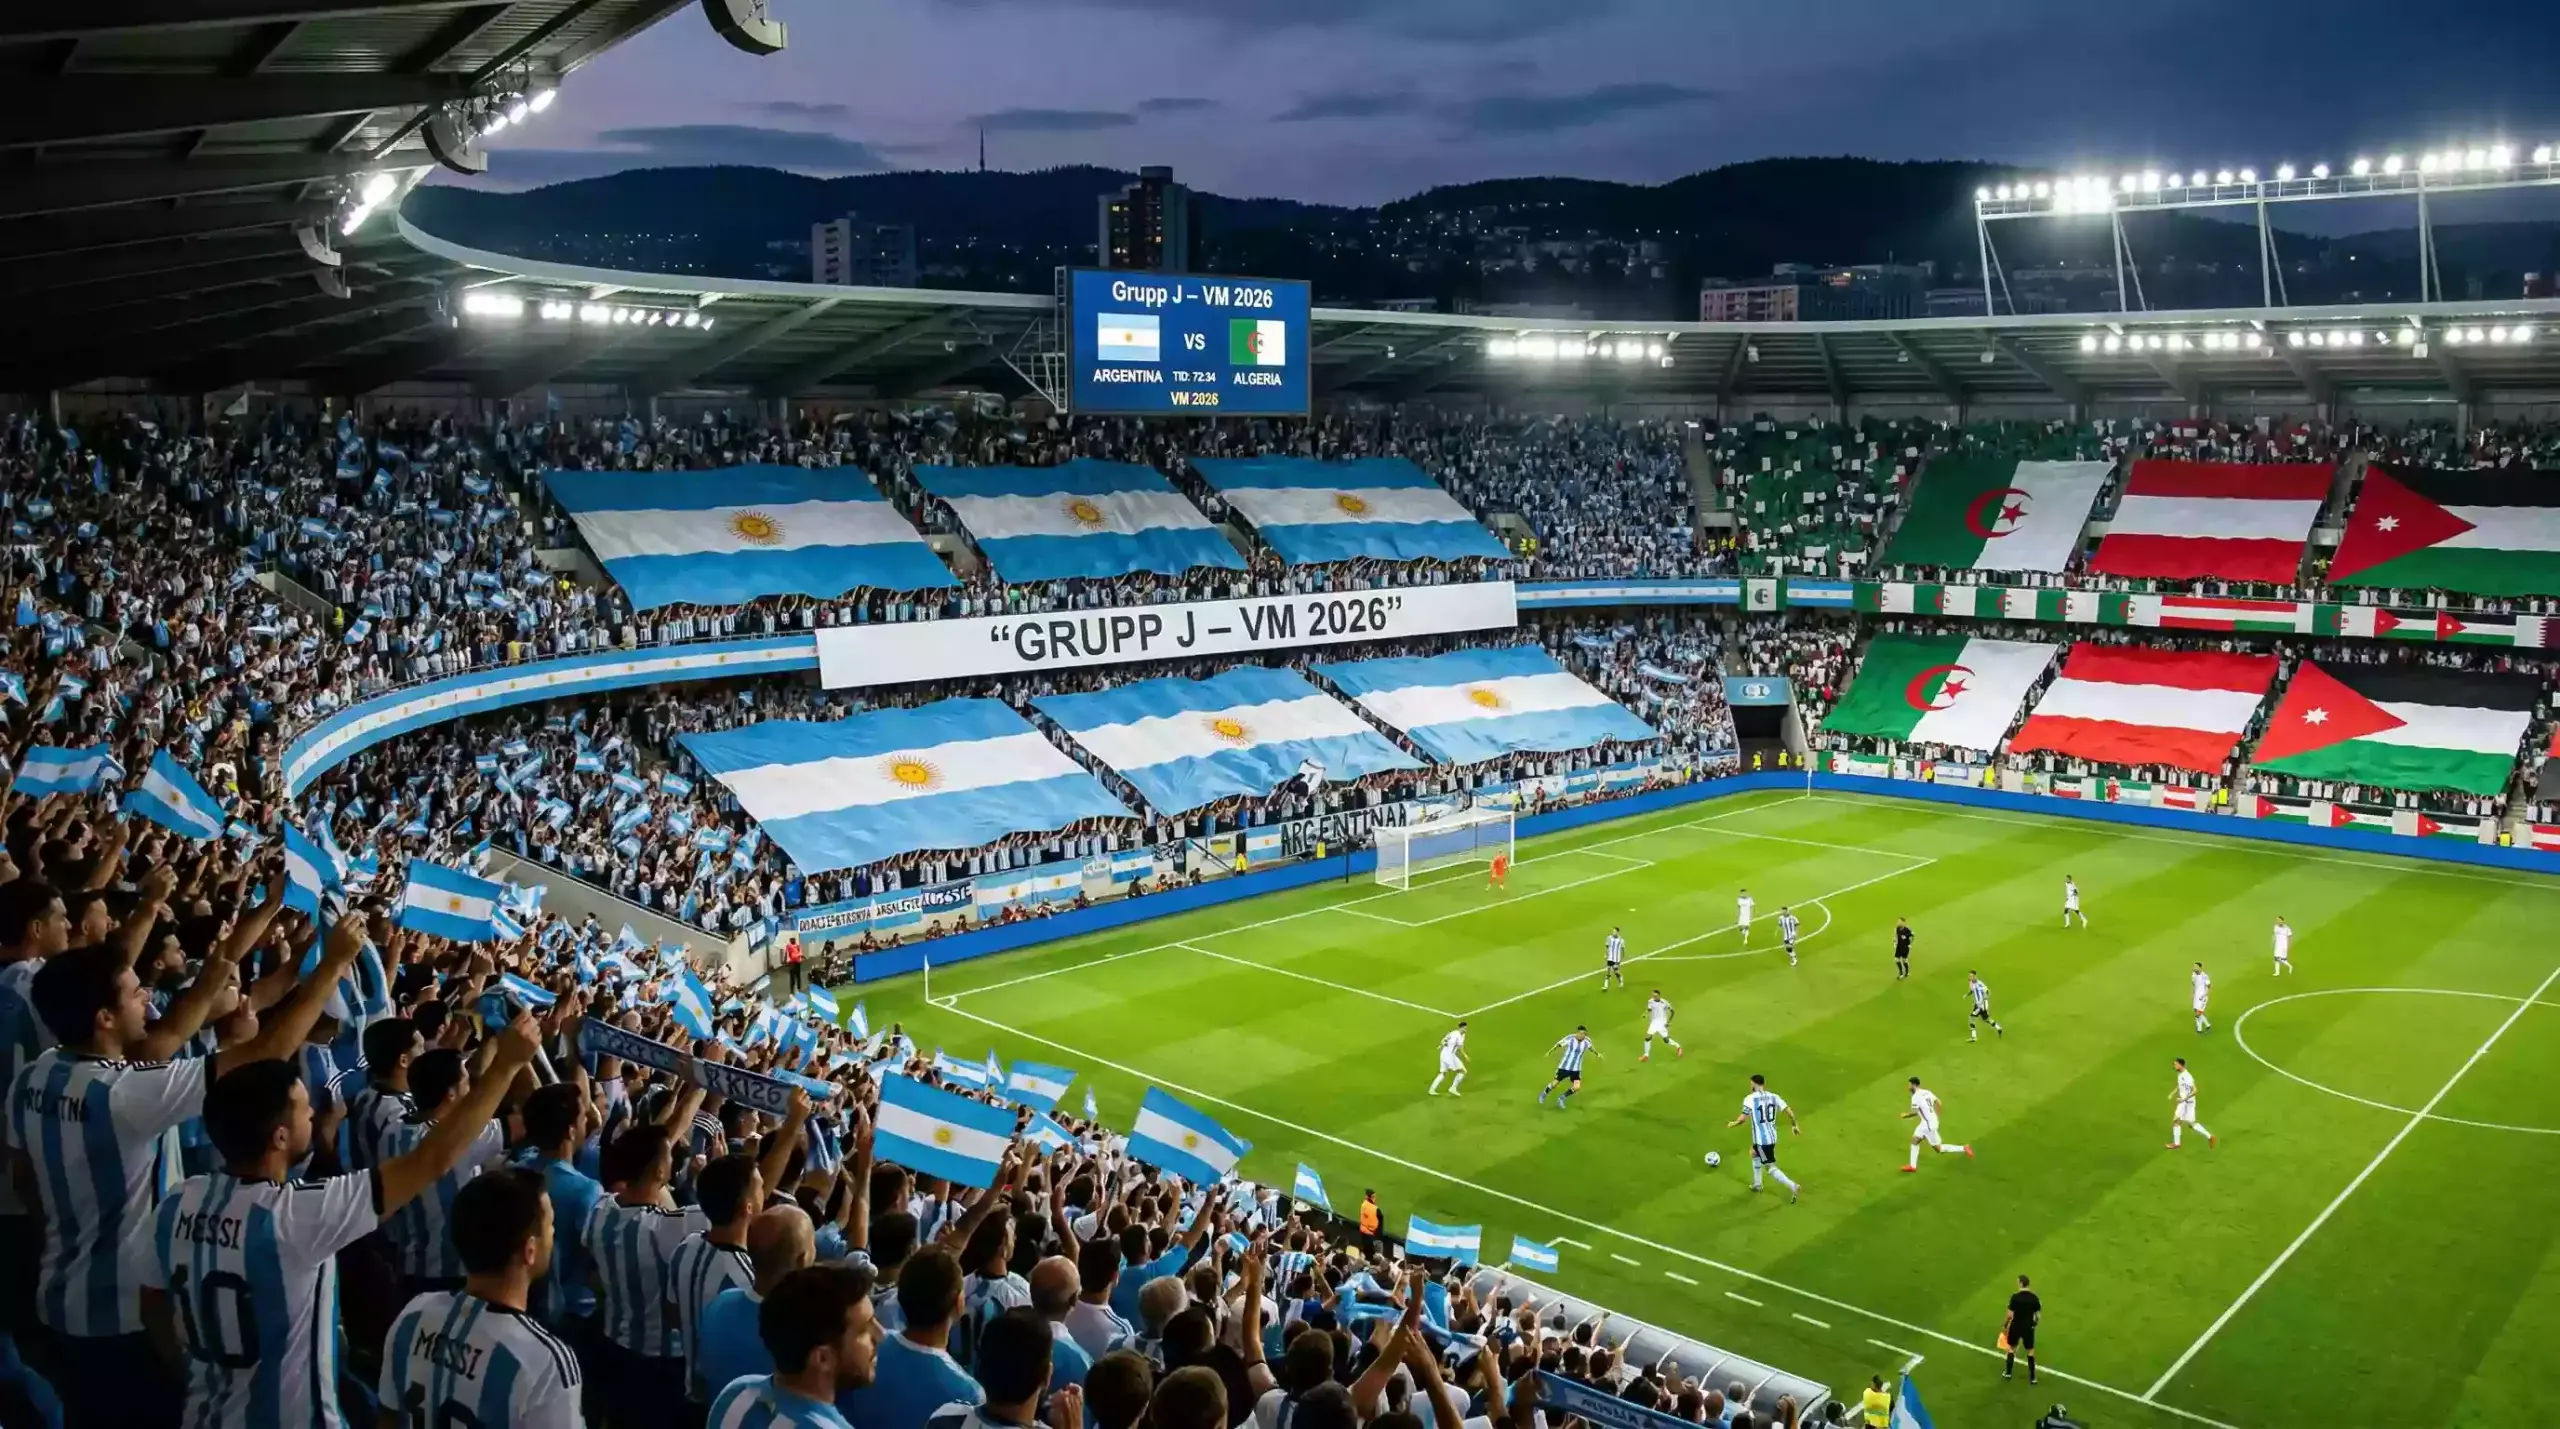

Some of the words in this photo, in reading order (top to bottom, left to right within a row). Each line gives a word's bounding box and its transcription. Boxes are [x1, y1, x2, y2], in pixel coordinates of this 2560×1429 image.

[1112, 280, 1168, 308] Grupp
[1172, 284, 1182, 304] J
[1202, 285, 1229, 306] VM
[1234, 287, 1273, 309] 2026
[1184, 333, 1205, 350] VS
[1093, 368, 1163, 383] ARGENTINA
[1233, 372, 1282, 386] ALGERIA
[1170, 391, 1189, 405] VM
[1191, 391, 1219, 406] 2026
[1177, 610, 1195, 648] J
[1239, 603, 1296, 641] VM
[1757, 1103, 1776, 1124] 10
[174, 1208, 243, 1250] MESSI
[412, 1328, 484, 1381] MESSI
